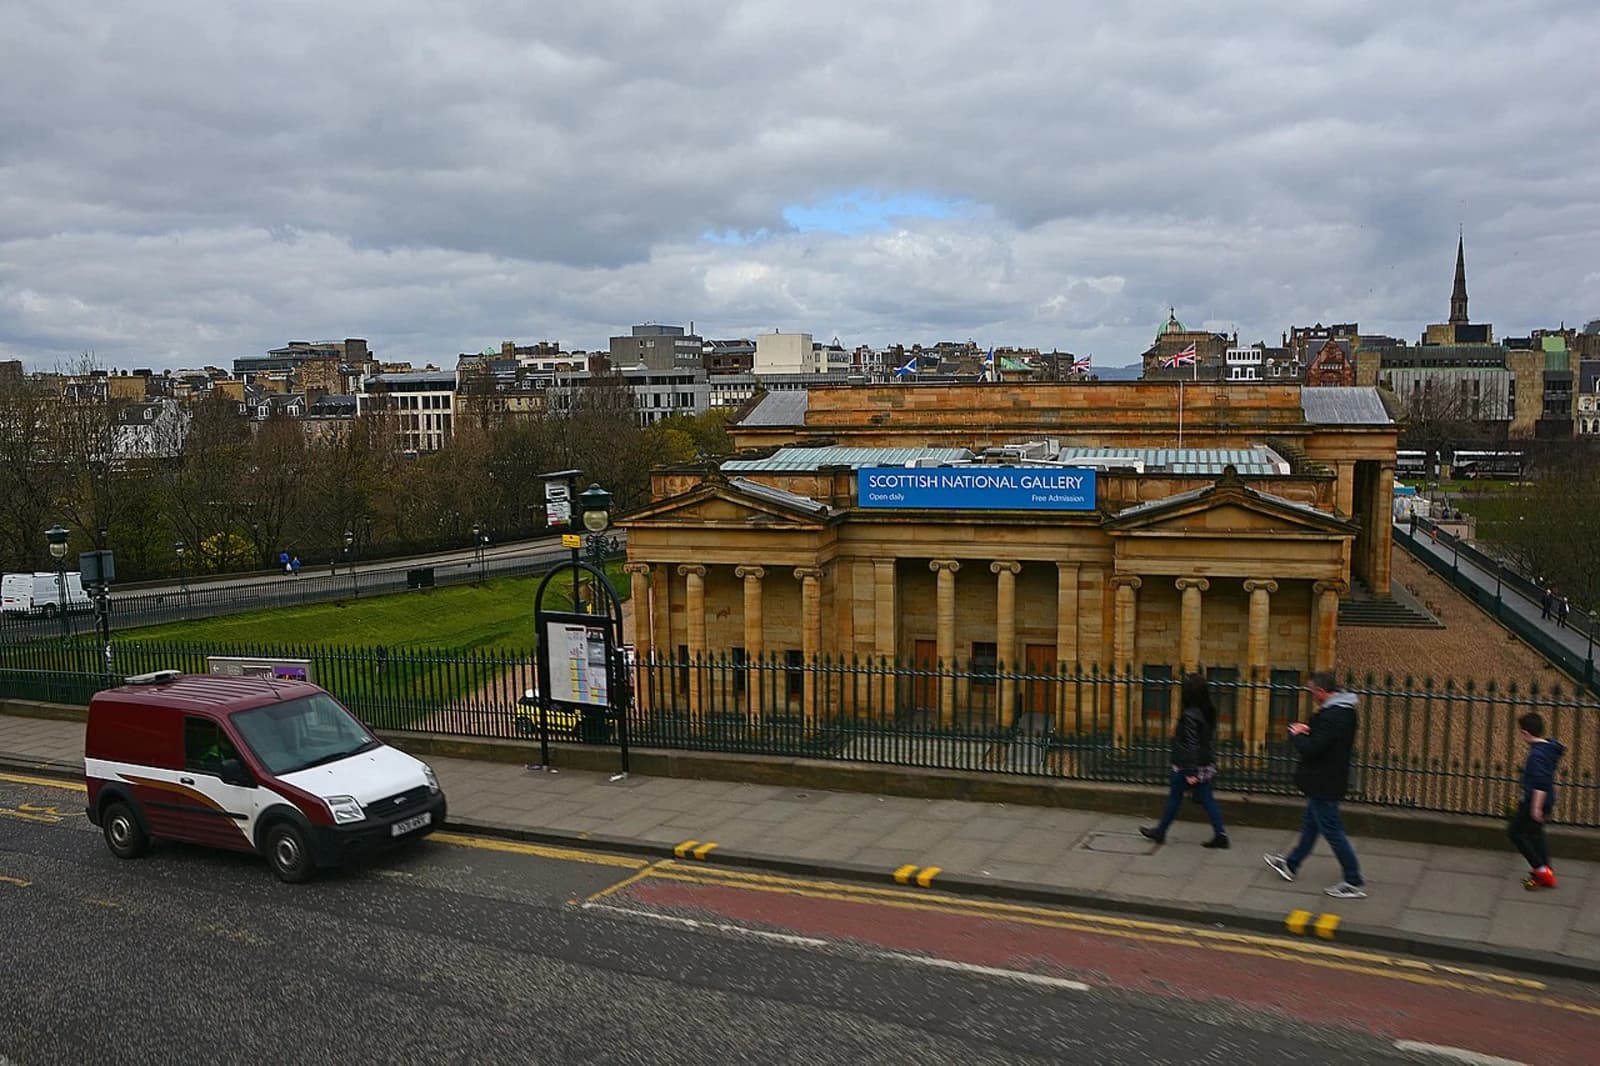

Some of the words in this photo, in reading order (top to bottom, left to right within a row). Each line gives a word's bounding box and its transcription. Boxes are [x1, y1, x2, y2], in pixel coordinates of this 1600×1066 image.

[869, 475, 938, 488] SCOTTISH
[942, 475, 1018, 489] NATIONAL
[1020, 475, 1084, 489] GALLERY
[869, 493, 888, 501] Open
[889, 493, 904, 501] daily
[1031, 494, 1047, 502] Free
[1048, 494, 1085, 503] Admission
